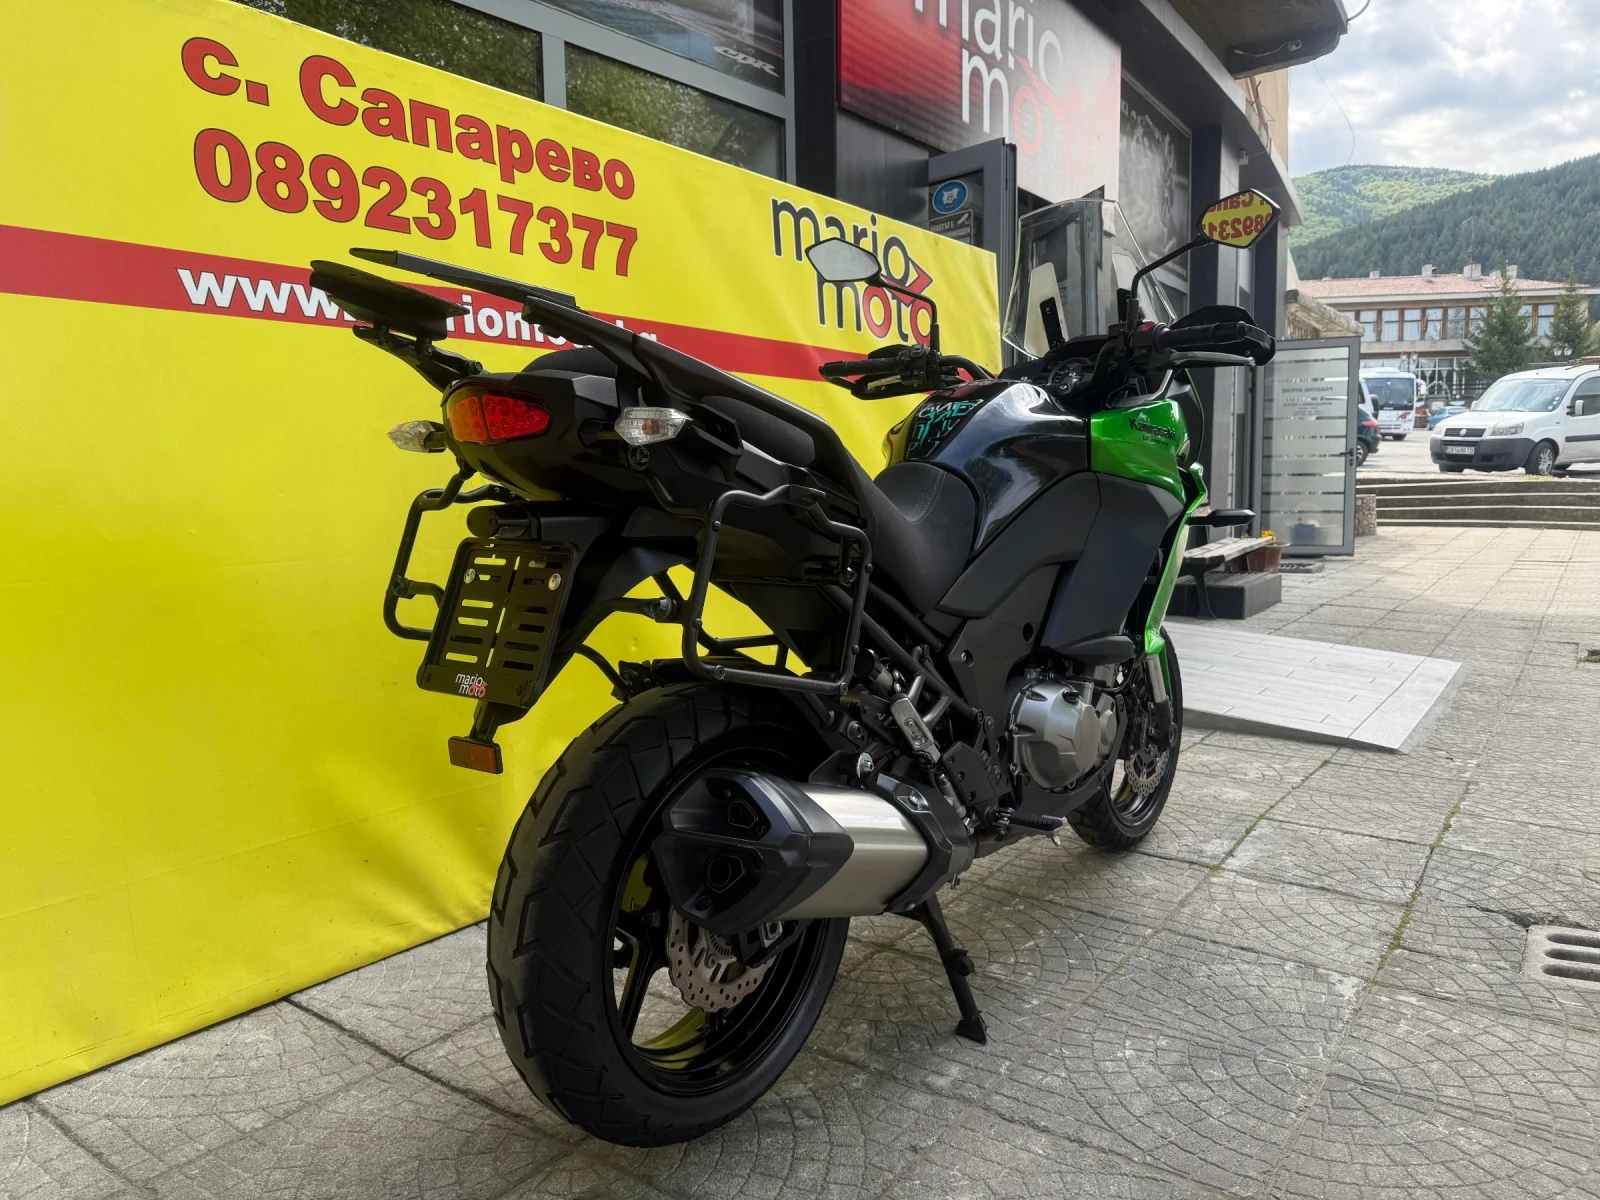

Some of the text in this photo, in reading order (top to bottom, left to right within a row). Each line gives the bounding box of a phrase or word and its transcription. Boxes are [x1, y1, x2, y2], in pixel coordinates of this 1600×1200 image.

[180, 36, 636, 201] с. Сапарево
[193, 127, 639, 278] 0892317377
[455, 673, 483, 686] mario
[459, 684, 486, 697] moto
